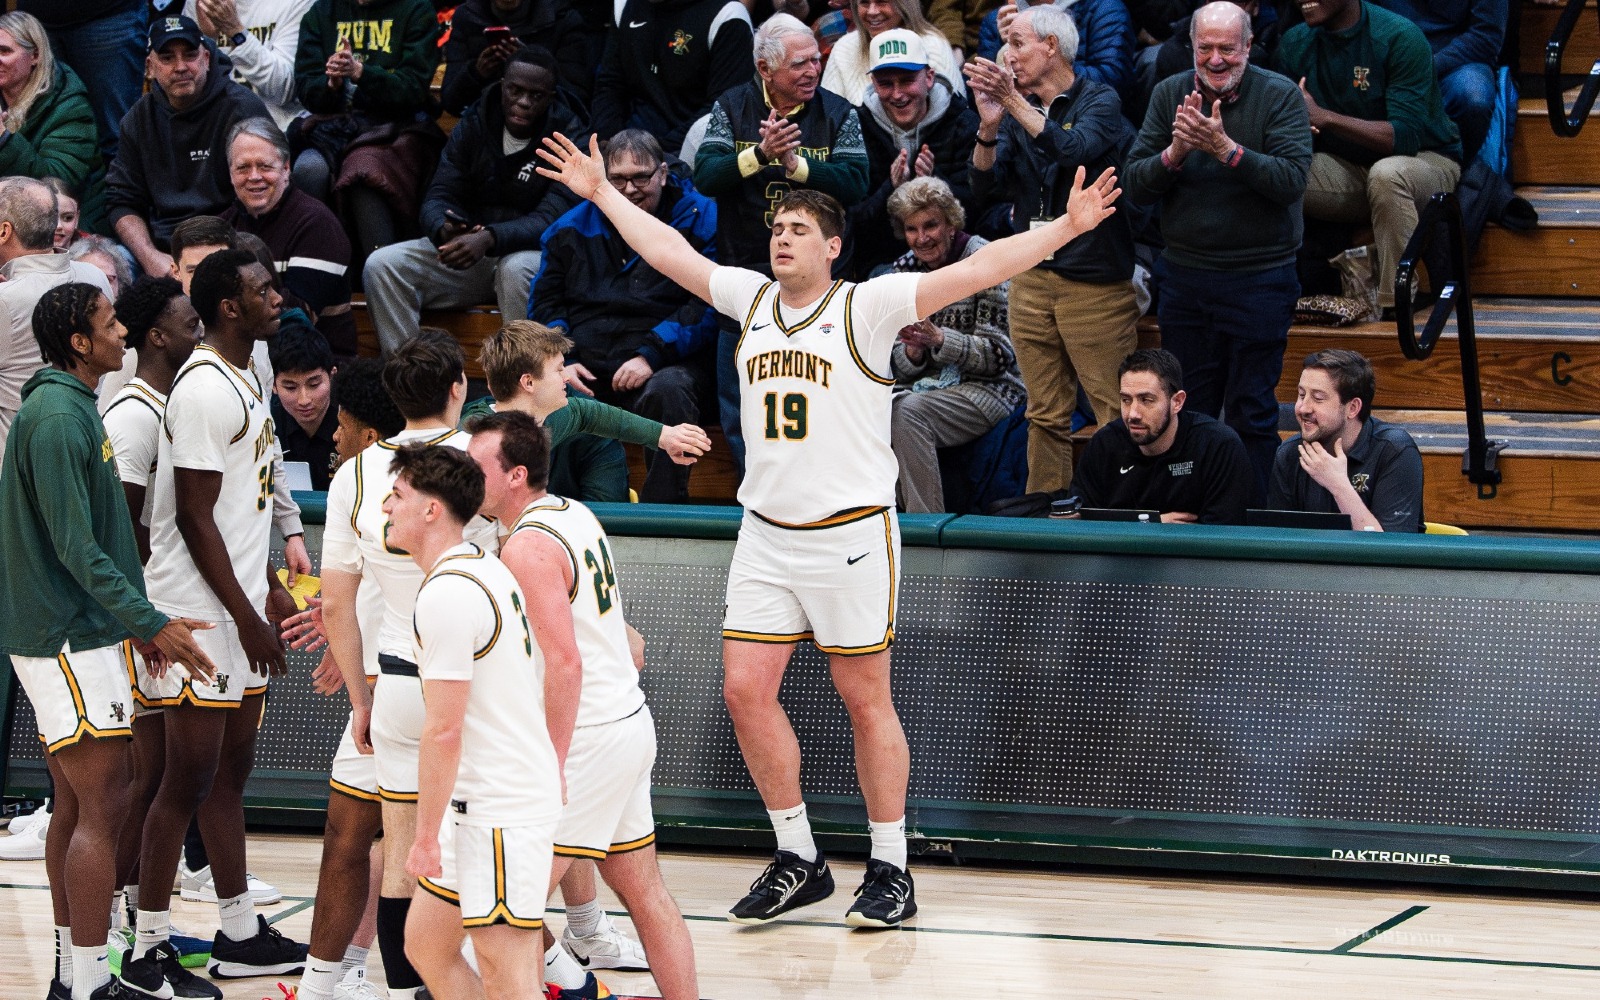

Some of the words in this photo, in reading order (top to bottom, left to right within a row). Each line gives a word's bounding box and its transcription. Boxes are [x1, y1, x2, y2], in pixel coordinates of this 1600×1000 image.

[746, 349, 833, 390] VERMONT
[1552, 352, 1572, 387] C
[763, 391, 809, 441] 19
[584, 535, 619, 618] 24
[1332, 849, 1451, 865] DAKTRONICS
